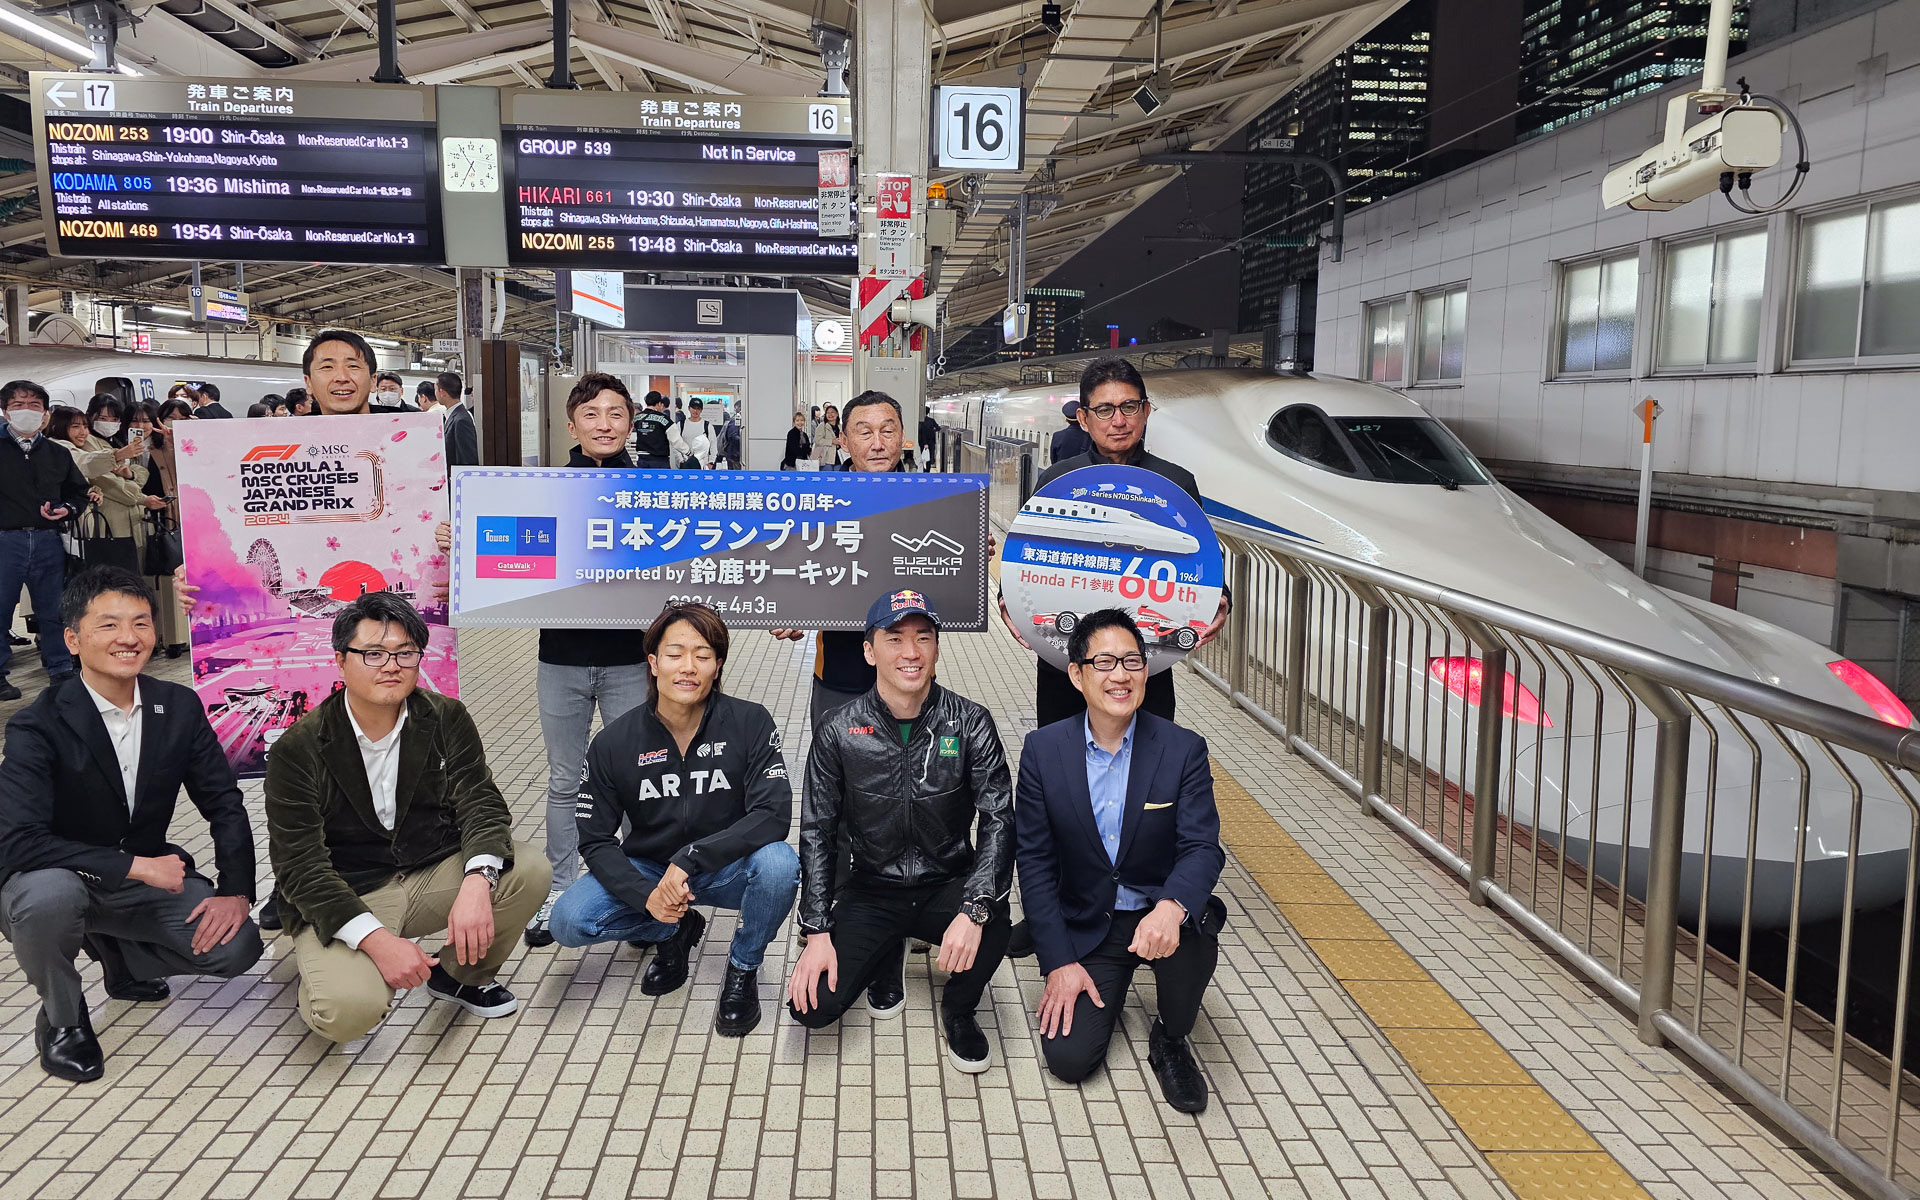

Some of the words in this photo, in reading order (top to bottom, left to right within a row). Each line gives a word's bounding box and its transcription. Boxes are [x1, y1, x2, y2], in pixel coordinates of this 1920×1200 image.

[86, 84, 109, 107] 17
[187, 84, 294, 102] 発車ご案内
[188, 100, 220, 112] Train
[223, 101, 294, 115] Departures
[640, 100, 741, 117] 発車ご案内
[641, 115, 671, 128] Train
[675, 117, 741, 130] Departures
[812, 109, 834, 130] 16
[953, 102, 1004, 152] 16
[49, 123, 114, 141] NOZOMI
[119, 127, 149, 140] 253
[163, 127, 214, 144] 19:00
[221, 130, 286, 145] Shin-Ōsaka
[360, 136, 377, 147] Car
[519, 138, 577, 154] GROUP
[584, 142, 612, 154] 539
[702, 145, 728, 159] Not
[731, 146, 743, 159] in
[746, 146, 796, 161] Service
[820, 154, 847, 163] STOP
[53, 173, 118, 191] KODAMA
[123, 177, 152, 190] 805
[166, 177, 218, 193] 19:36
[224, 178, 291, 195] Mishima
[879, 181, 910, 191] STOP
[519, 186, 581, 204] HIKARI
[586, 191, 612, 203] 661
[627, 190, 674, 206] 19:30
[682, 193, 742, 207] Shin-Ōsaka
[821, 190, 846, 199] 非常停止
[821, 202, 846, 210] ボタン
[59, 220, 124, 238] NOZOMI
[129, 224, 158, 237] 469
[171, 224, 222, 240] 19:54
[229, 226, 293, 241] Shin-Ōsaka
[367, 232, 383, 243] Car
[880, 220, 907, 228] 非常停止
[522, 233, 583, 250] NOZOMI
[588, 237, 615, 249] 255
[629, 236, 676, 252] 19:48
[683, 239, 743, 253] Shin-Ōsaka
[813, 244, 828, 255] Car
[191, 287, 202, 297] 16
[1017, 305, 1026, 315] 16
[141, 381, 154, 400] 16
[321, 444, 349, 455] MSC
[240, 461, 331, 475] FORMULA
[334, 460, 344, 472] 1
[241, 475, 282, 488] MSC
[286, 472, 359, 486] CRUISES
[243, 486, 335, 500] JAPANESE
[1091, 490, 1112, 499] Series
[1112, 493, 1130, 501] N700
[243, 500, 309, 513] GRAND
[312, 497, 354, 510] PRIX
[244, 514, 290, 526] 2024
[586, 517, 864, 554] 日本グランプリ号
[892, 556, 963, 566] SUZUKA
[1023, 547, 1122, 572] 東海道新幹線開業
[575, 566, 661, 584] supported
[665, 566, 685, 584] by
[689, 557, 869, 586] 鈴鹿サーキット
[894, 566, 960, 576] CIRCUIT
[1180, 572, 1199, 583] 1964
[1021, 570, 1065, 588] Honda
[1071, 575, 1088, 590] F1
[891, 601, 910, 611] Red
[910, 599, 927, 611] Bull
[848, 726, 874, 735] TOM'S
